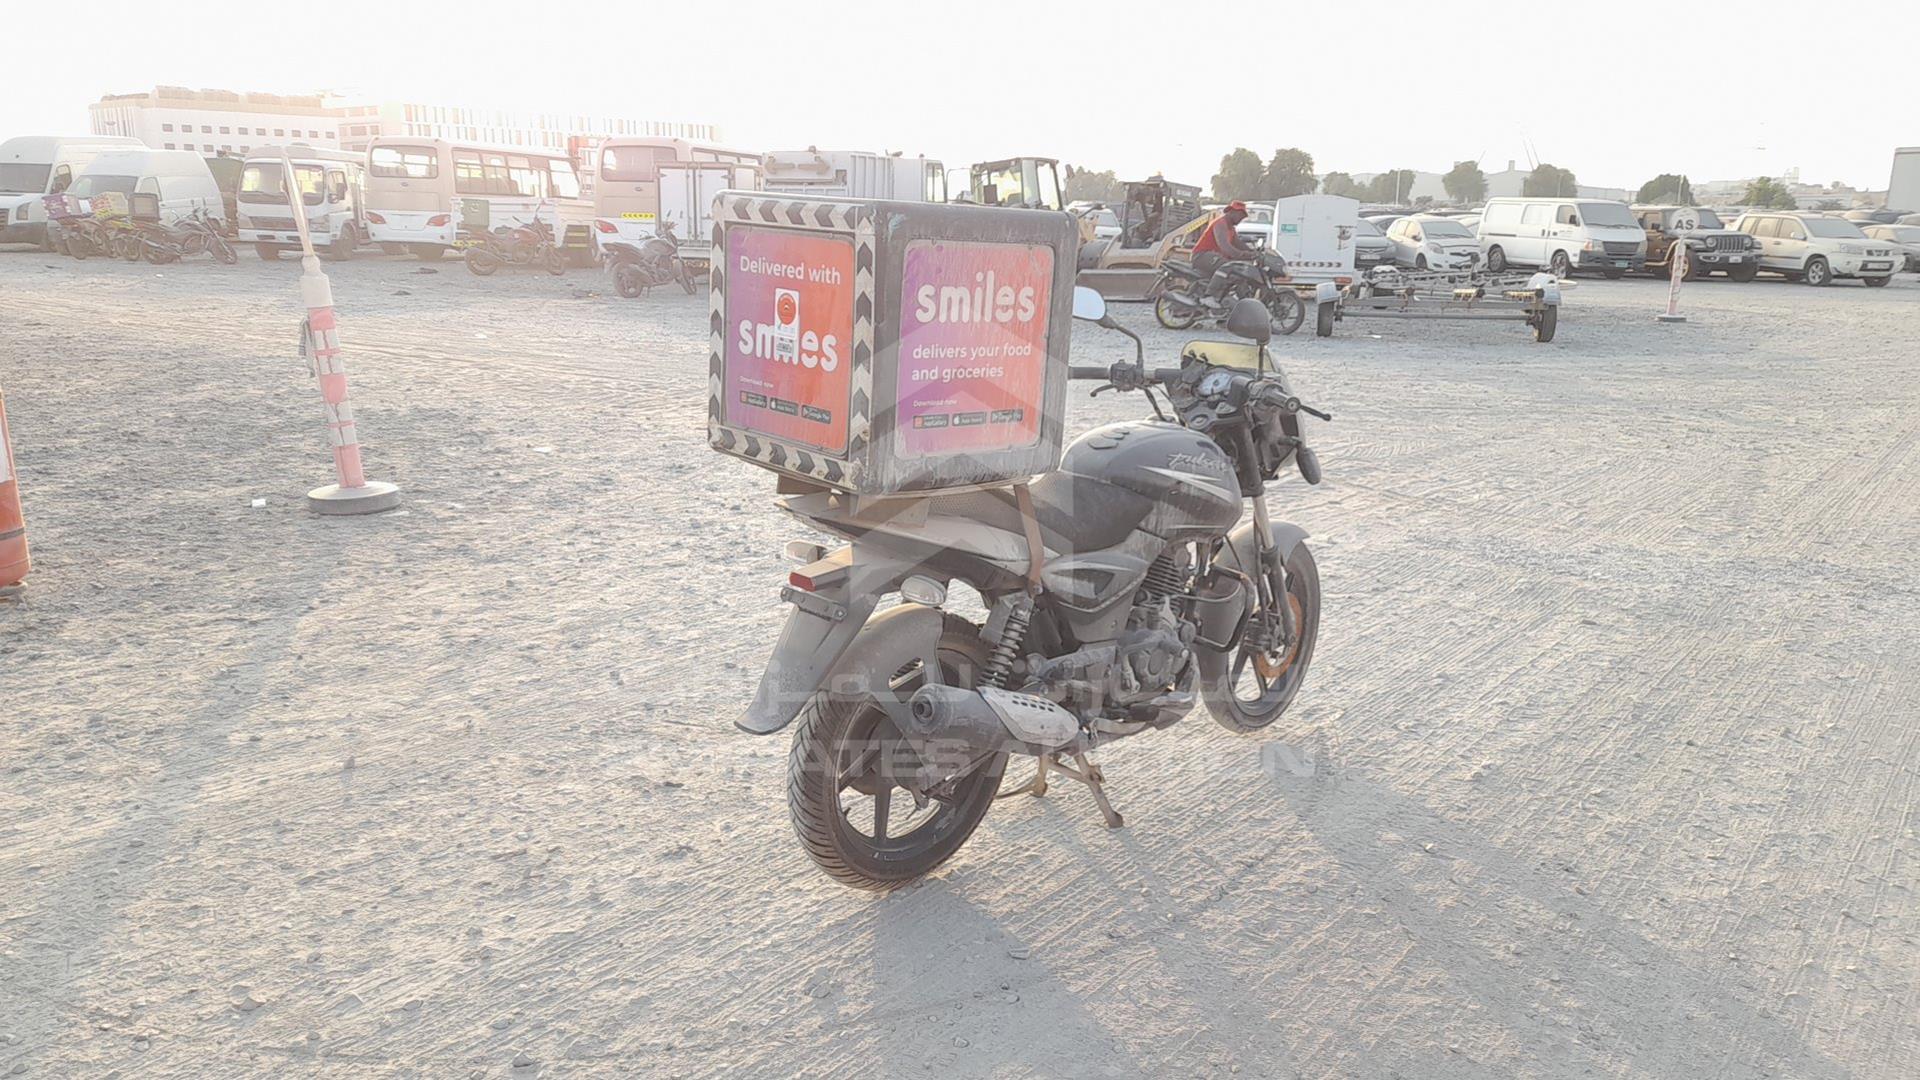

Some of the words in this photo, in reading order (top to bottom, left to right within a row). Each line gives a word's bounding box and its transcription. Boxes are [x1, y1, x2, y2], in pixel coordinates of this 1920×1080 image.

[1674, 218, 1695, 230] AS
[740, 257, 805, 280] Delivered
[808, 264, 842, 285] with
[915, 270, 1035, 323] smiles
[738, 319, 838, 372] smles
[912, 343, 967, 359] delivers
[970, 345, 999, 361] your
[1003, 342, 1032, 356] food
[911, 365, 939, 381] and
[942, 363, 1004, 382] groceries
